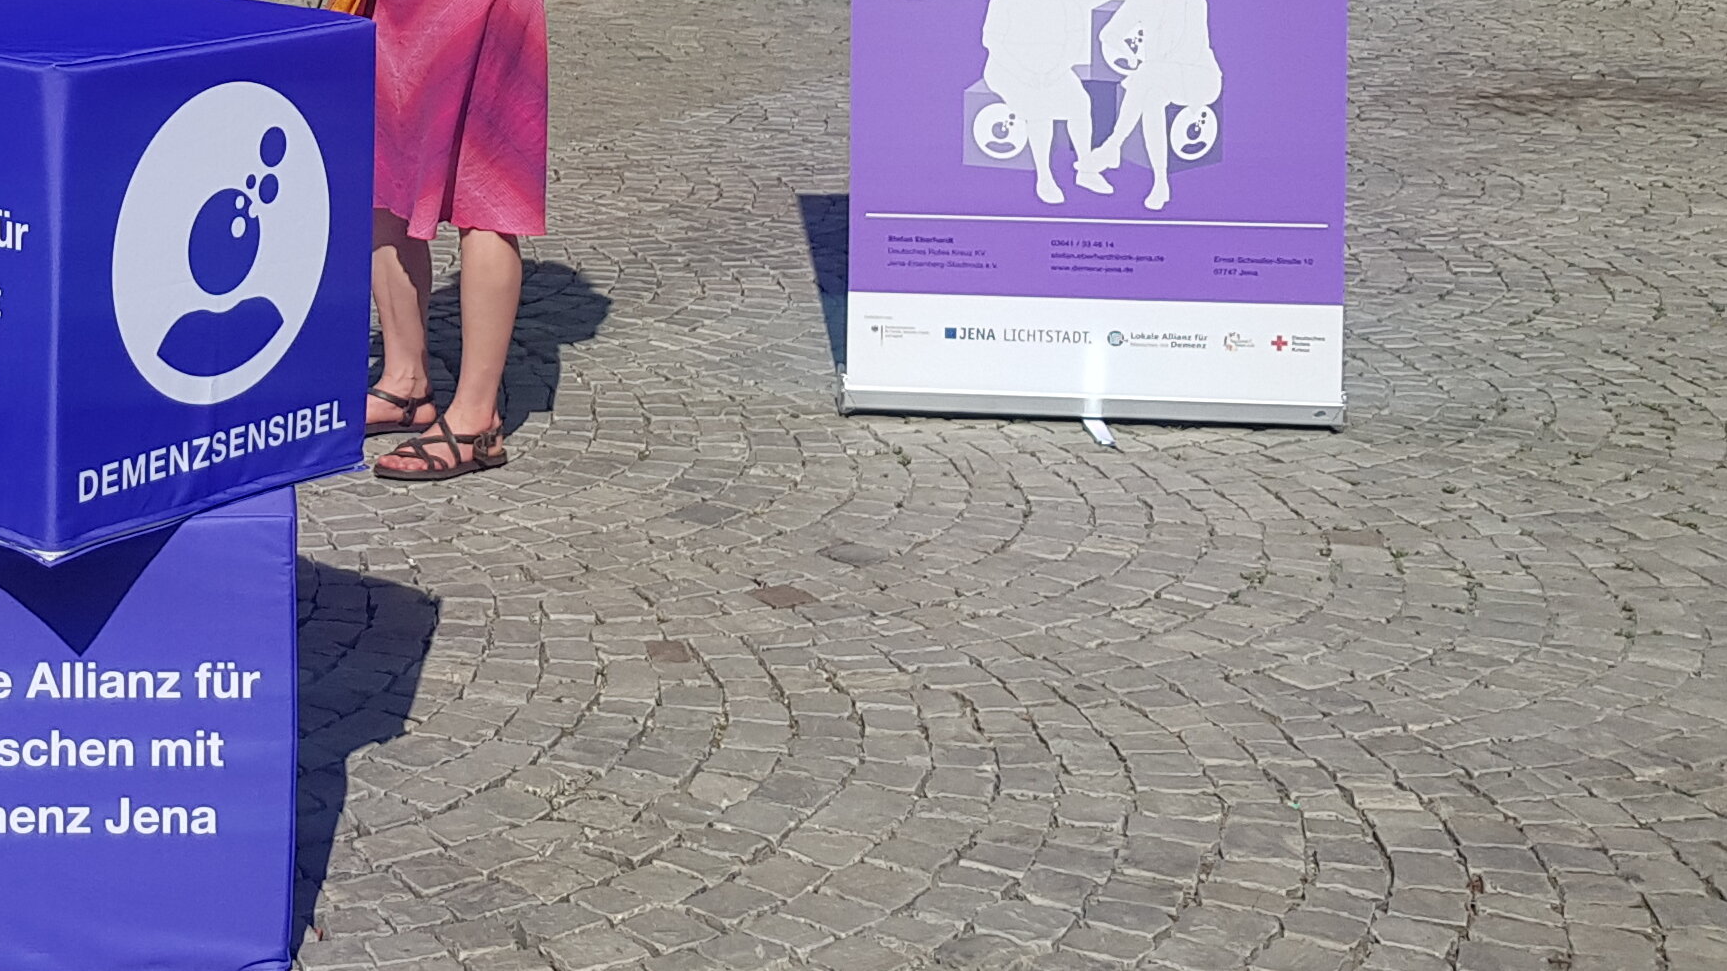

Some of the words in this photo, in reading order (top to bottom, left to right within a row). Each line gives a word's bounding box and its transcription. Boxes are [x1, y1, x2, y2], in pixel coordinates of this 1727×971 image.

[959, 327, 996, 341] JENA
[1130, 332, 1159, 340] Lokale
[1161, 333, 1192, 341] Allianz
[1194, 334, 1208, 342] für
[1170, 341, 1207, 349] Demenz
[78, 400, 347, 503] DEMENZSENSIBEL
[25, 661, 181, 699] Allianz
[194, 662, 260, 699] für
[150, 729, 225, 767] mit
[104, 796, 217, 834] Jena
